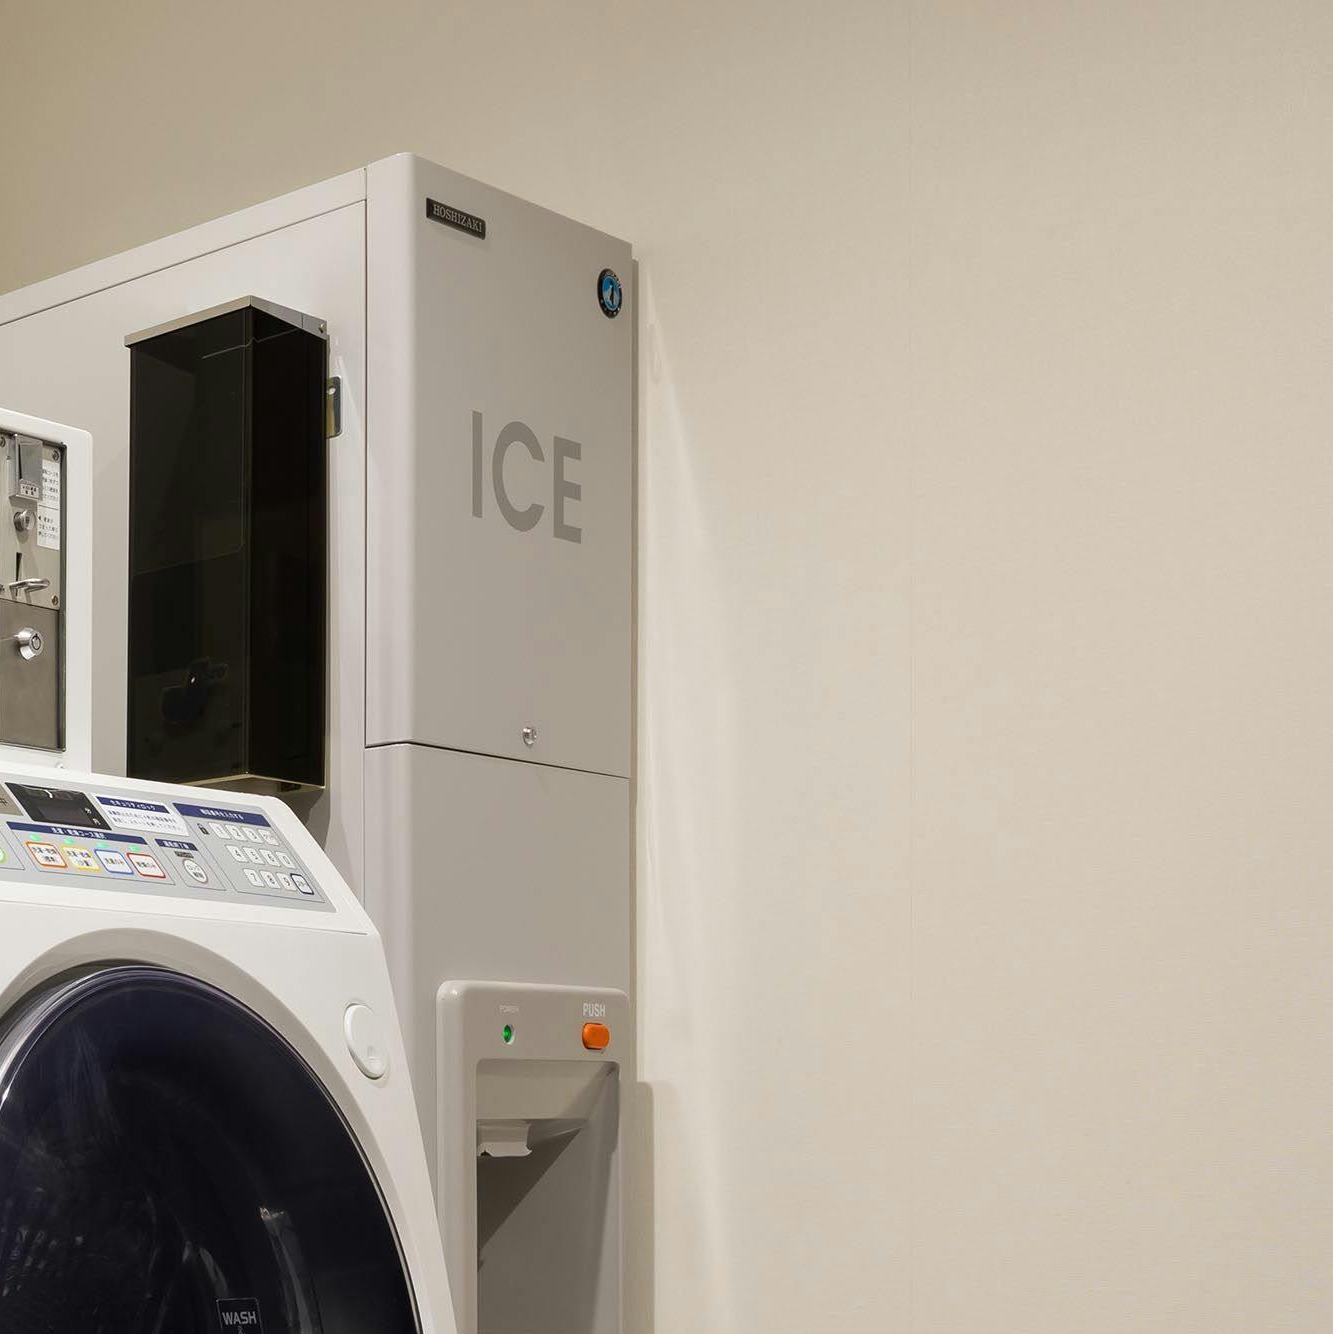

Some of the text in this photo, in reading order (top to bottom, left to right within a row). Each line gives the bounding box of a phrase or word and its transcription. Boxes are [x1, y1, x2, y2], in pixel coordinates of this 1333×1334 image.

[433, 204, 483, 233] HOSHIZAKI
[472, 409, 582, 545] ICE
[583, 1002, 606, 1017] PUSH
[222, 1311, 257, 1325] WASH
